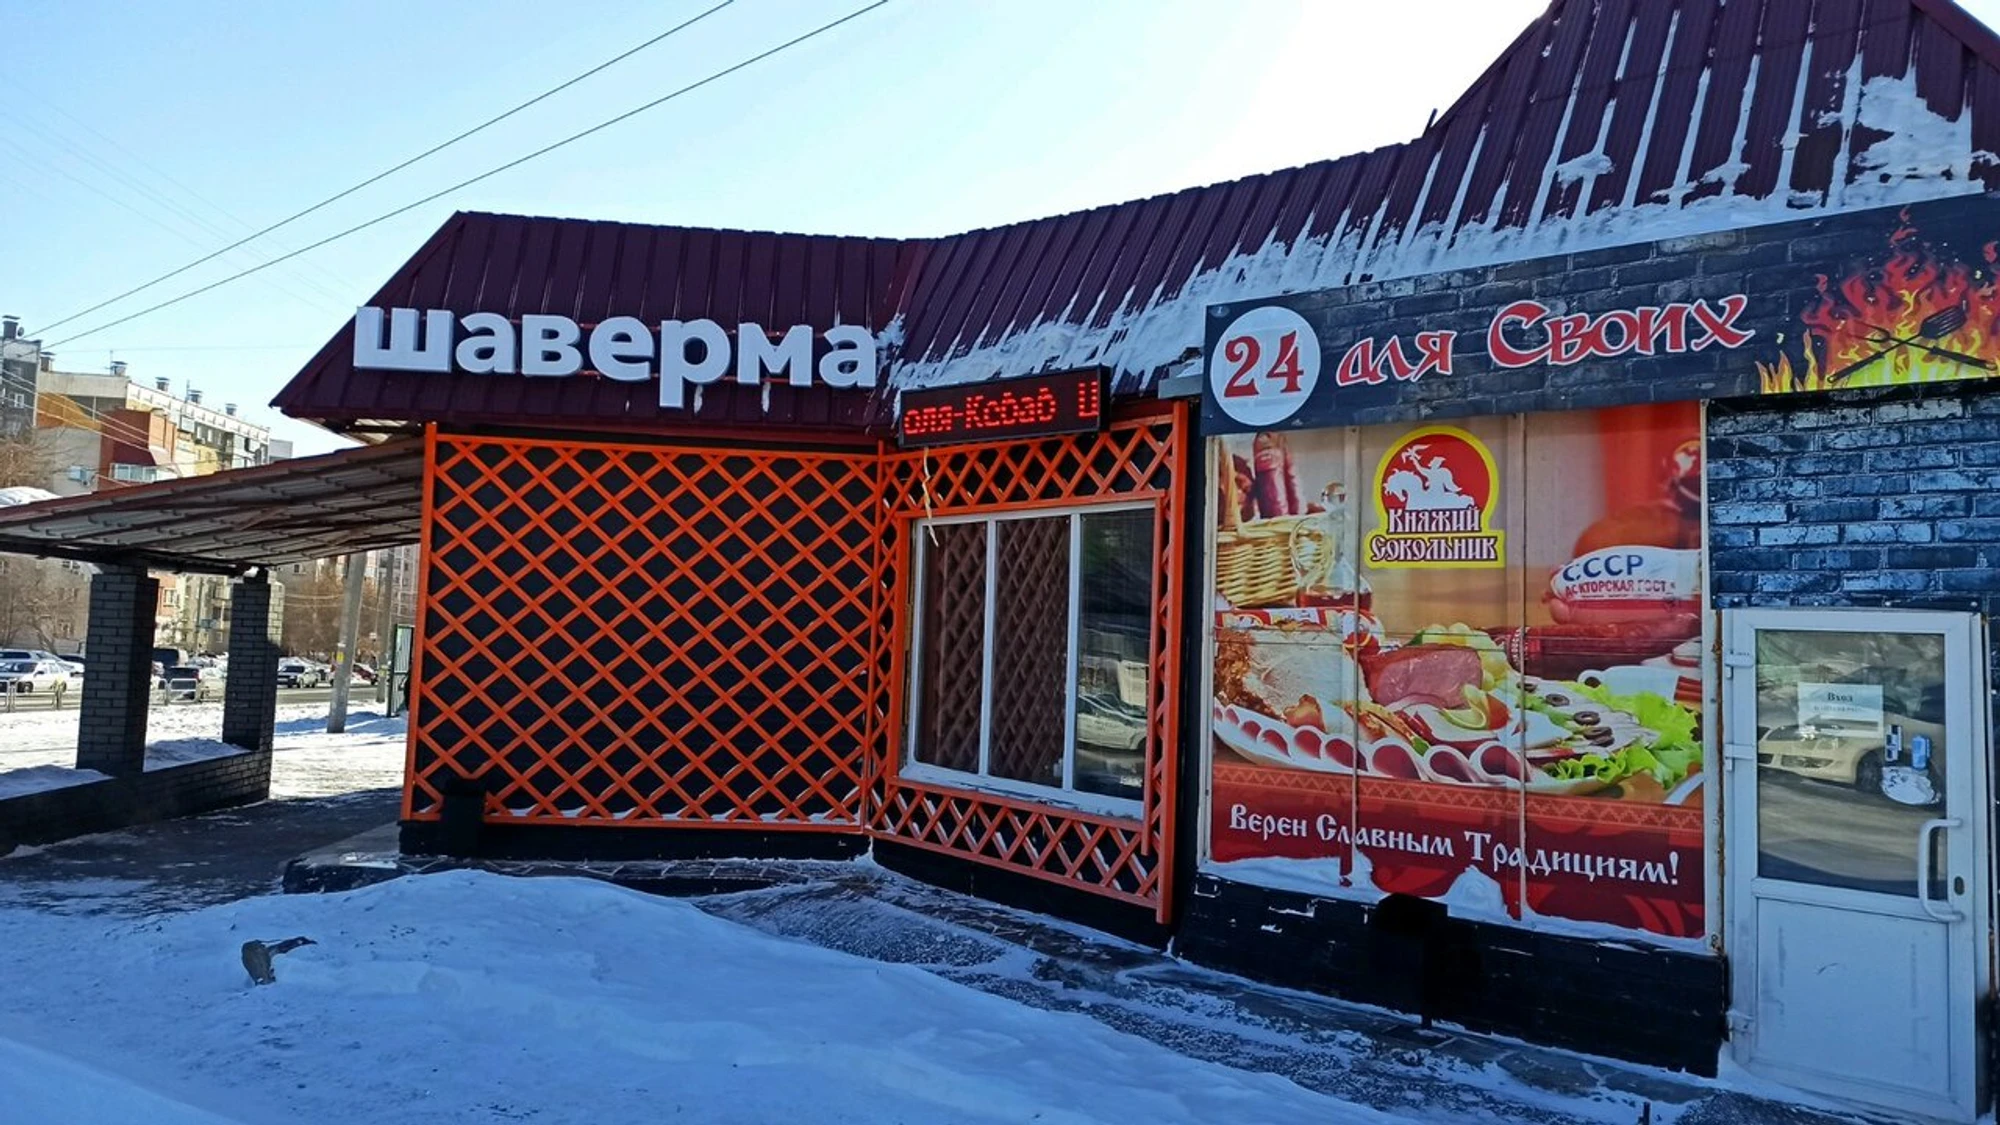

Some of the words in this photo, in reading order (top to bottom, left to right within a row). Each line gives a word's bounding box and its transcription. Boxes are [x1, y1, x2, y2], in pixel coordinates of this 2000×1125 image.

[353, 306, 877, 408] шаверма
[1223, 330, 1304, 398] 24
[1488, 294, 1754, 367] Своих
[1389, 507, 1480, 533] Княжий
[1372, 535, 1497, 561] Сокольник
[1562, 554, 1644, 582] СССР
[1229, 803, 1308, 841] Верен
[1316, 813, 1455, 857] Славным
[1464, 830, 1679, 884] Традициям!
